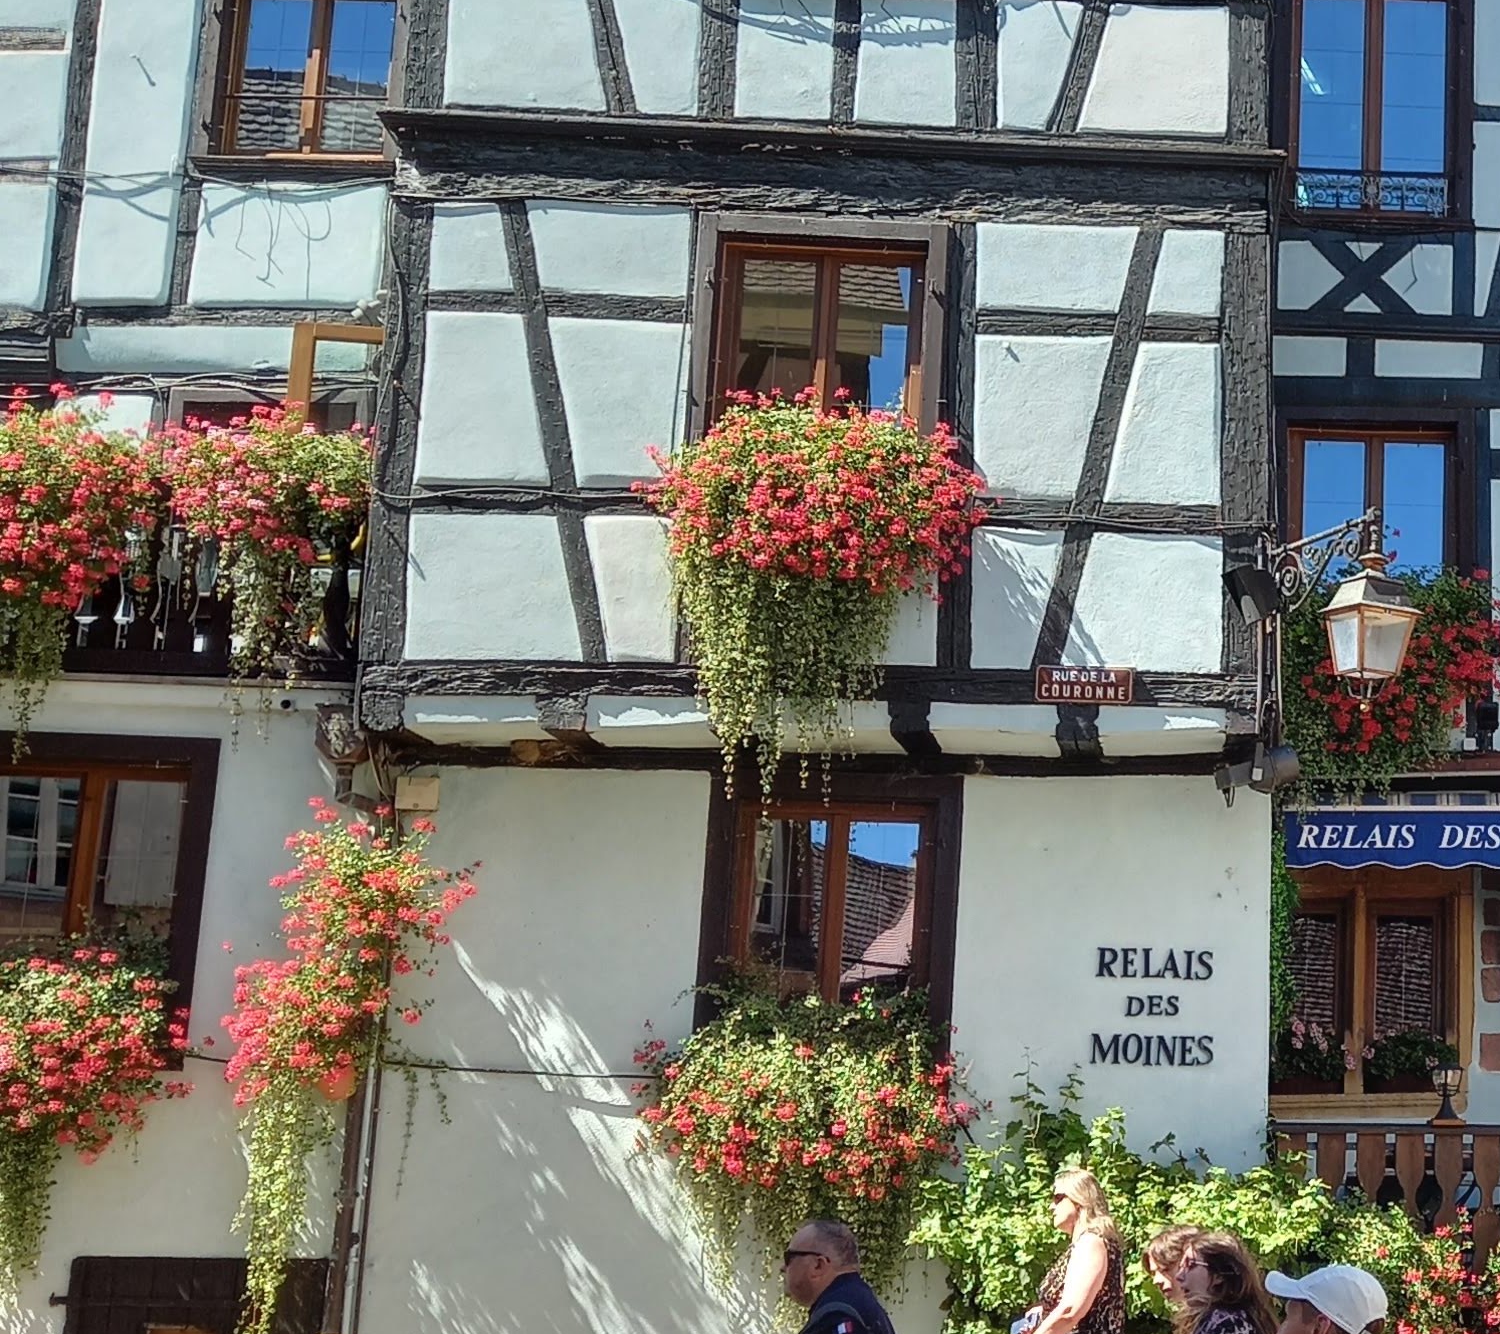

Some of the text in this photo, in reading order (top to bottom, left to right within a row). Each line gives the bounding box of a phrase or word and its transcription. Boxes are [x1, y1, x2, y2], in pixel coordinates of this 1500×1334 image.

[1052, 671, 1116, 683] RUE DE LA
[1041, 684, 1125, 699] COURONNE
[1297, 824, 1416, 849] RELAIS
[1095, 947, 1214, 980] RELAIS
[1124, 995, 1179, 1017] DES
[1089, 1033, 1214, 1067] MOINES
